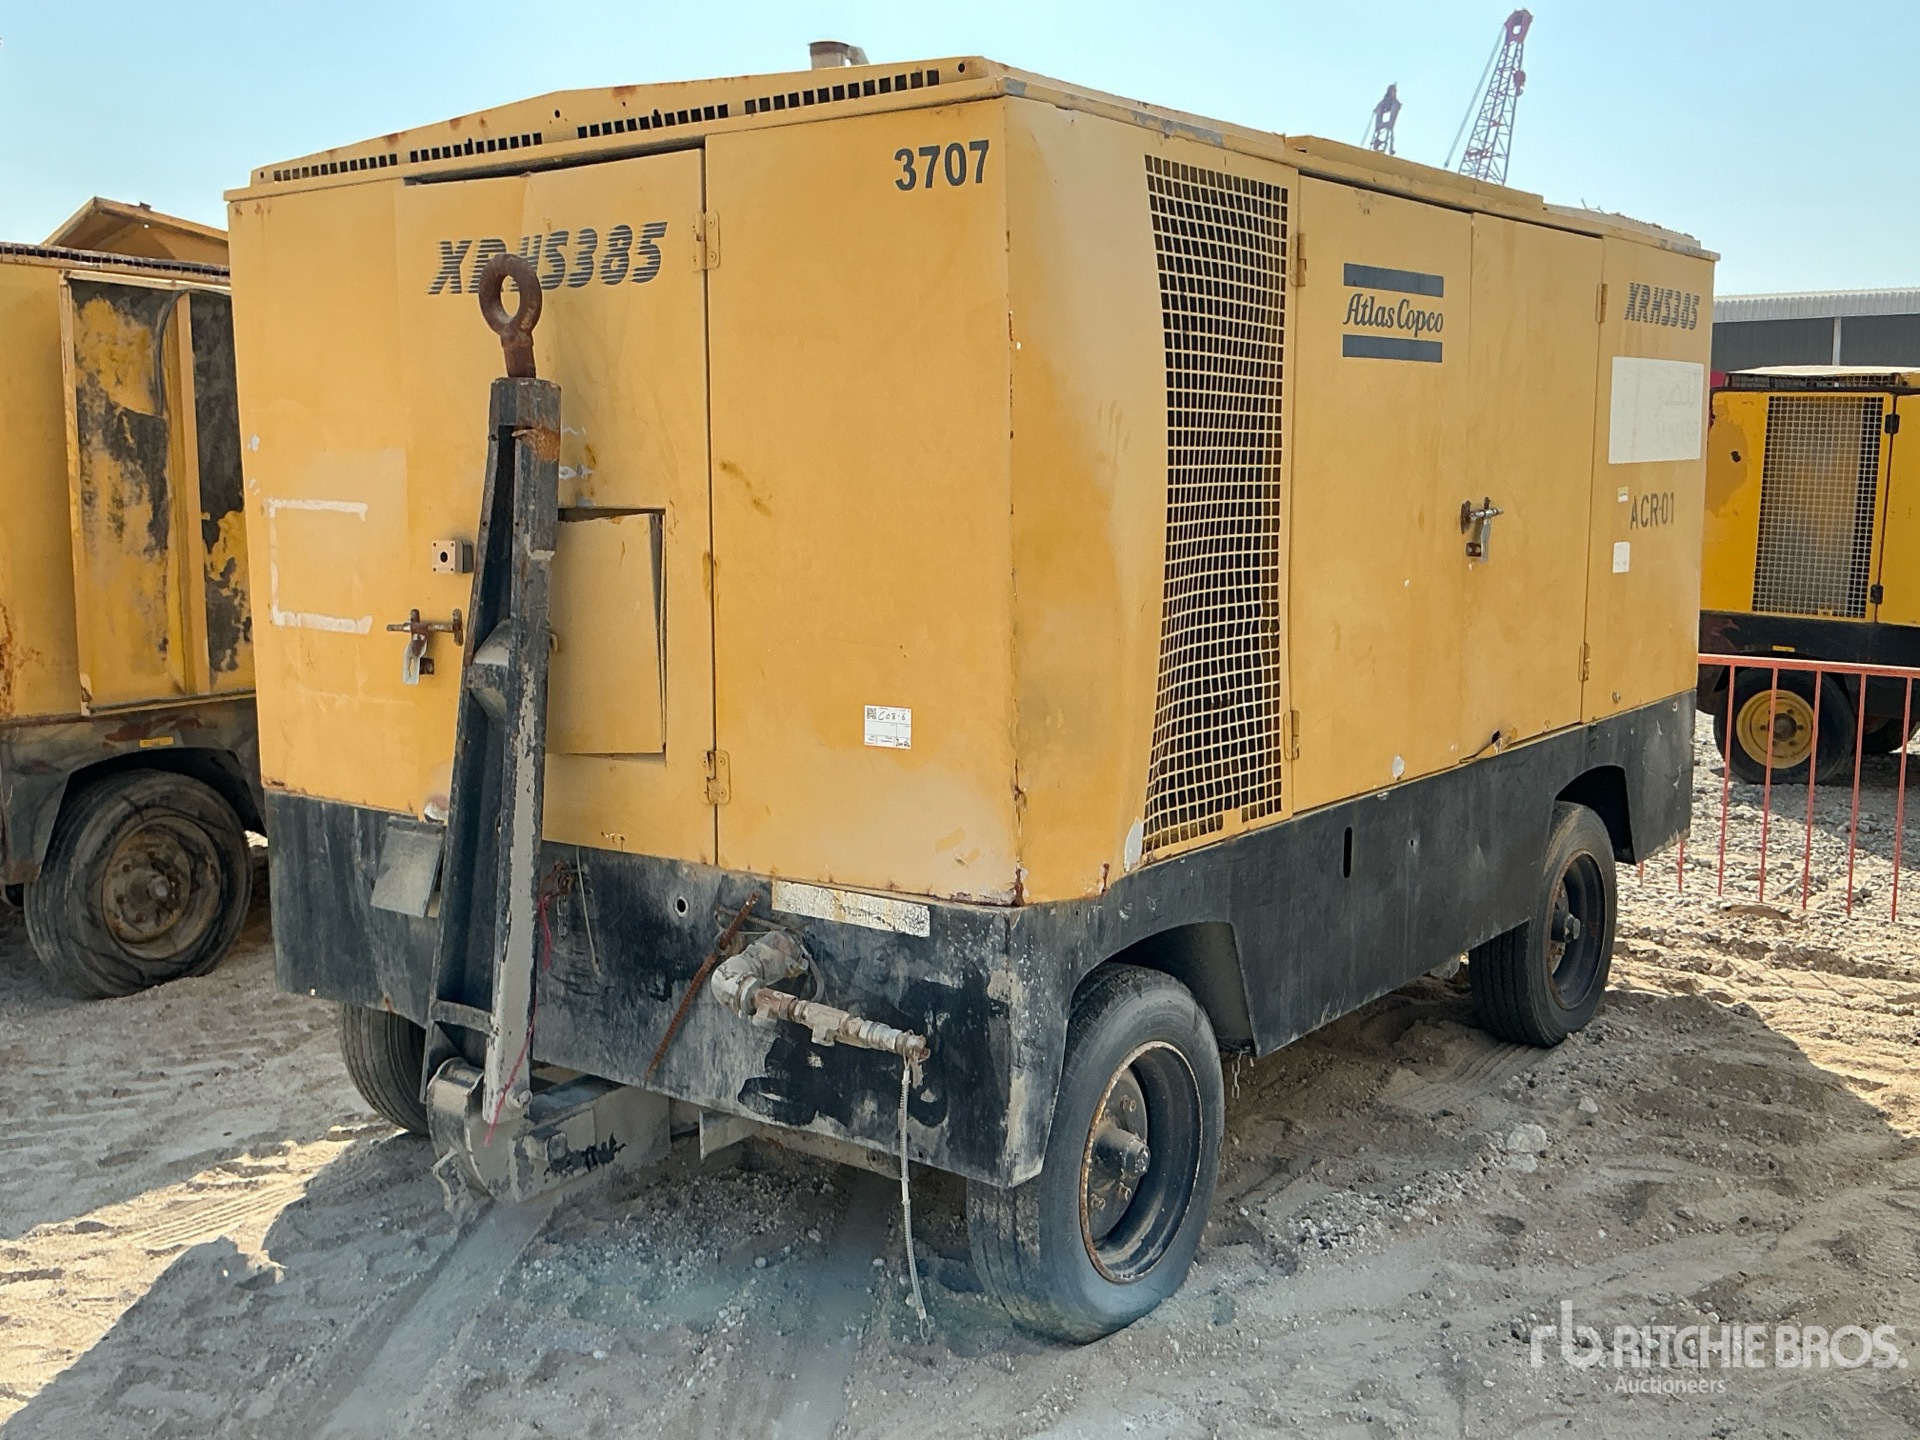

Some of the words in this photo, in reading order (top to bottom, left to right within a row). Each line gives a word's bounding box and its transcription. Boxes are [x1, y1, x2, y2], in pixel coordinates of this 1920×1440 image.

[894, 140, 989, 191] 3707
[1342, 293, 1395, 328] Atlas
[1396, 298, 1444, 338] Copco
